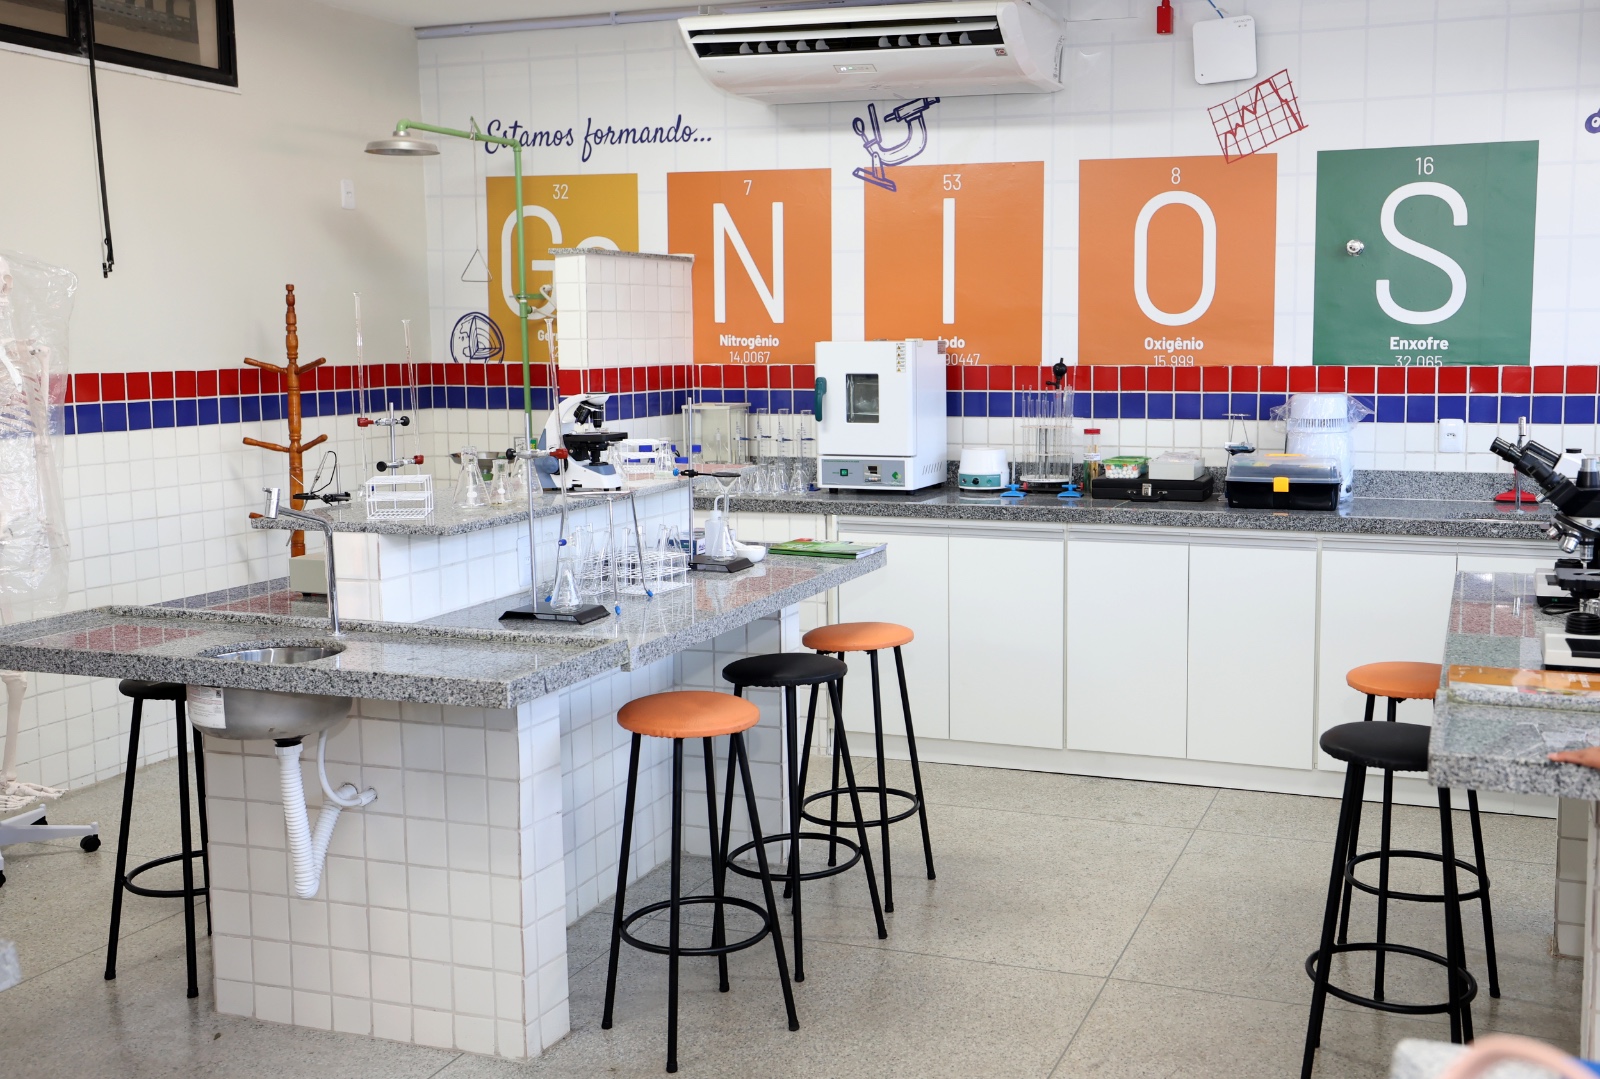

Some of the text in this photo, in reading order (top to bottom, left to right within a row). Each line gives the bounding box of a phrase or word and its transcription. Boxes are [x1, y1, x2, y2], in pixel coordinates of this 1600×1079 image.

[485, 114, 712, 163] Estamos formando...
[1415, 156, 1434, 175] 16
[942, 174, 962, 191] 53
[1170, 167, 1181, 184] 8
[552, 184, 569, 200] 32
[744, 180, 752, 195] 7
[1133, 190, 1217, 326] O
[1375, 181, 1469, 325] S
[713, 201, 785, 324] N
[719, 333, 780, 349] Nitrogênio
[1144, 336, 1204, 353] Oxigênio
[1389, 336, 1449, 350] Enxofre
[729, 350, 771, 364] 14,0067
[1394, 355, 1443, 367] 32065
